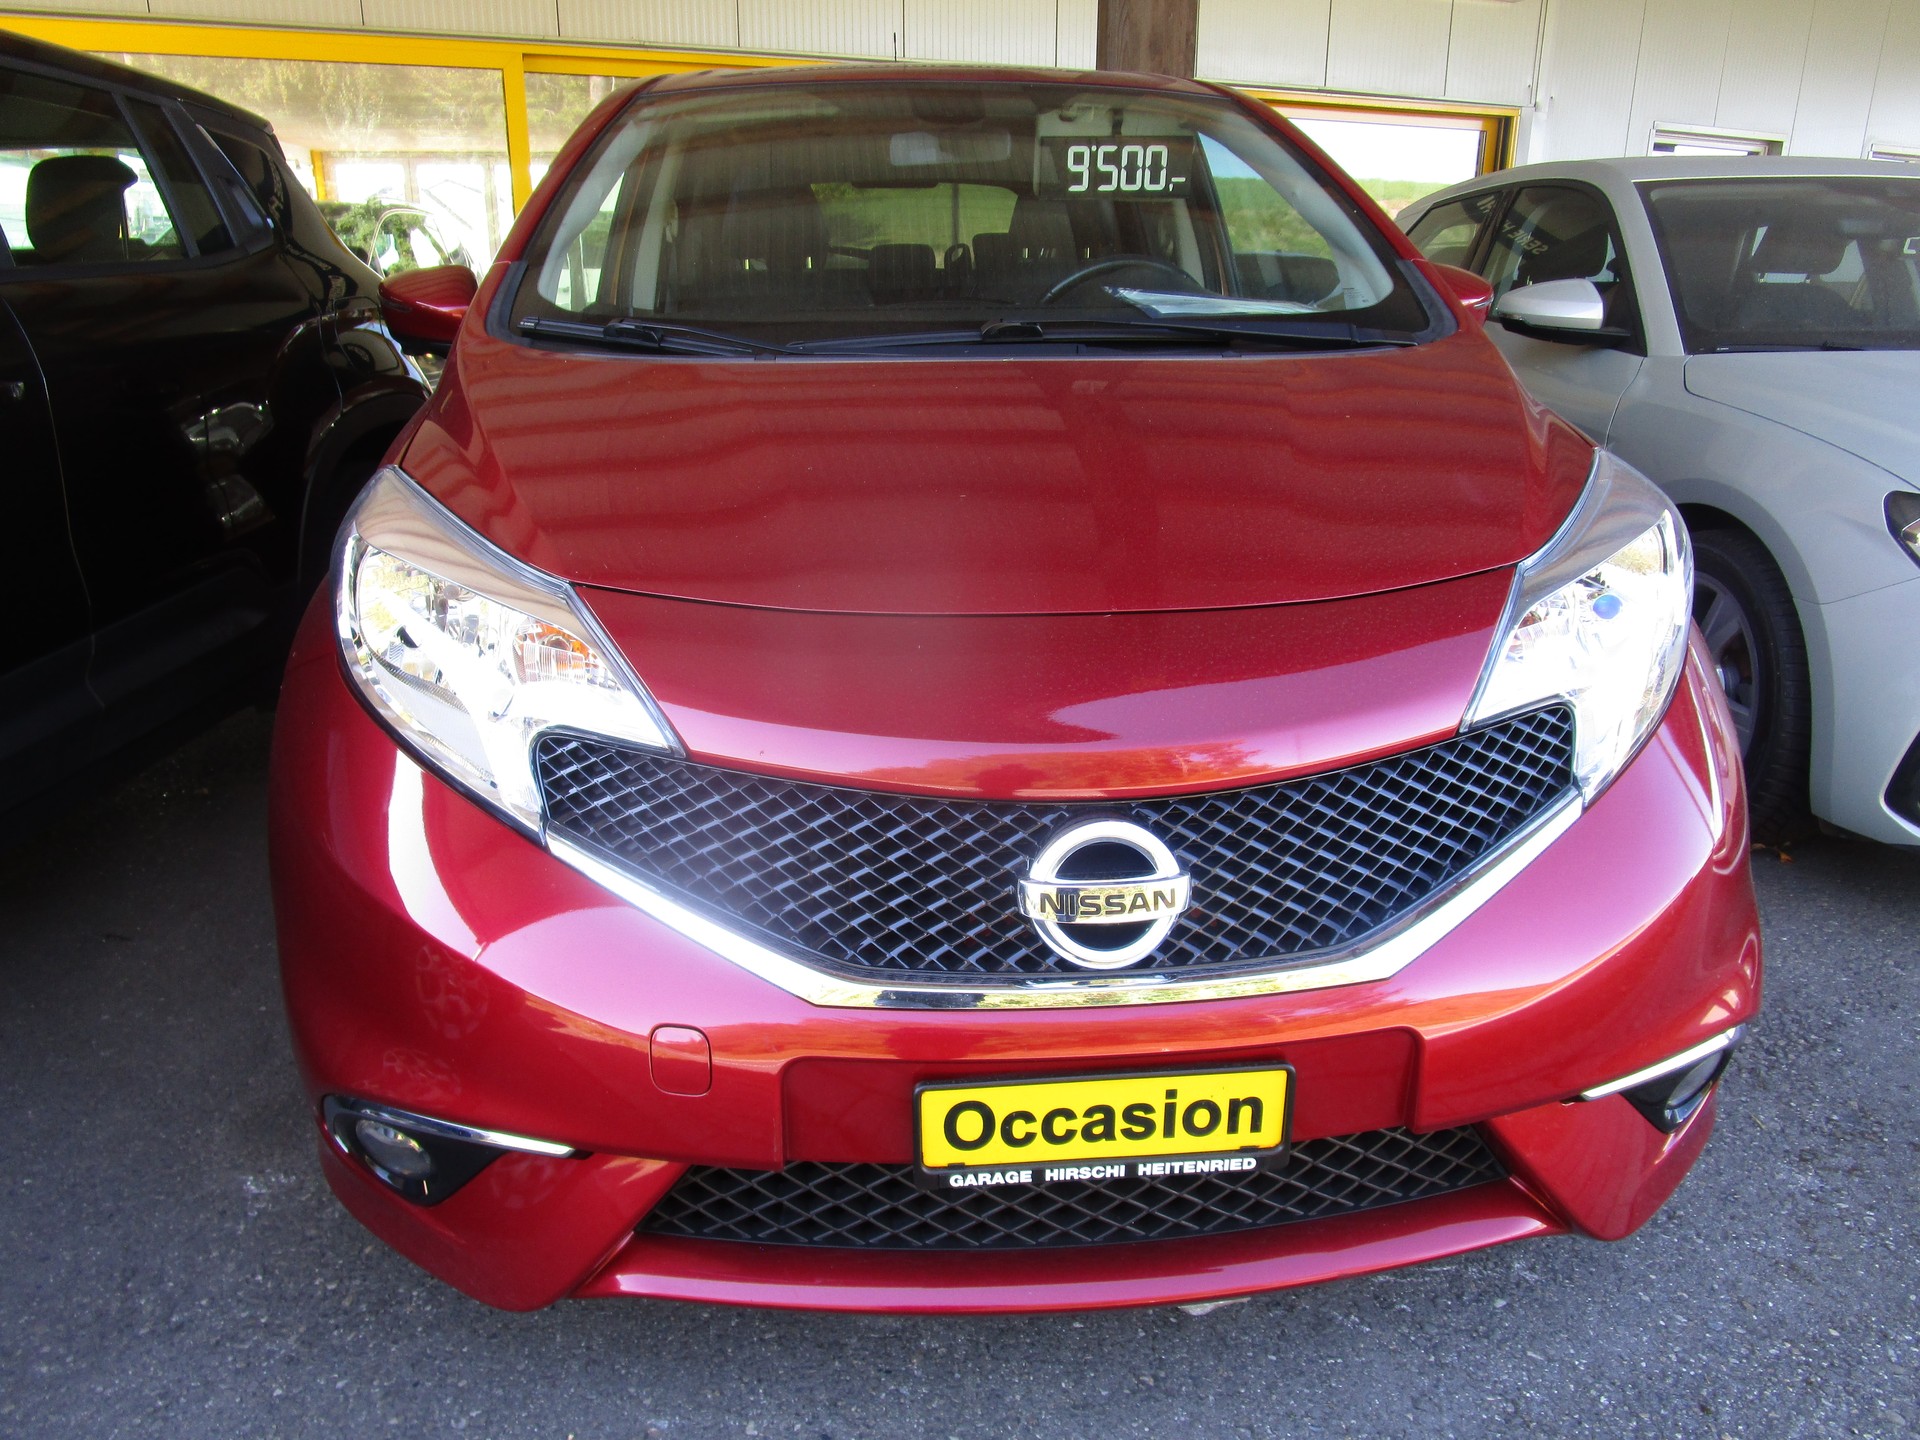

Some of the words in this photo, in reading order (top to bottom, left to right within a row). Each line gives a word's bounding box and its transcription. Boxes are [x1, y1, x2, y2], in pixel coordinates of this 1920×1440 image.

[1040, 888, 1176, 916] NISSAN
[943, 1089, 1264, 1151] Occasion
[949, 1170, 1033, 1188] GARAGE
[1045, 1164, 1126, 1182] HIRSCHI
[1137, 1157, 1258, 1177] HEITENRIED
